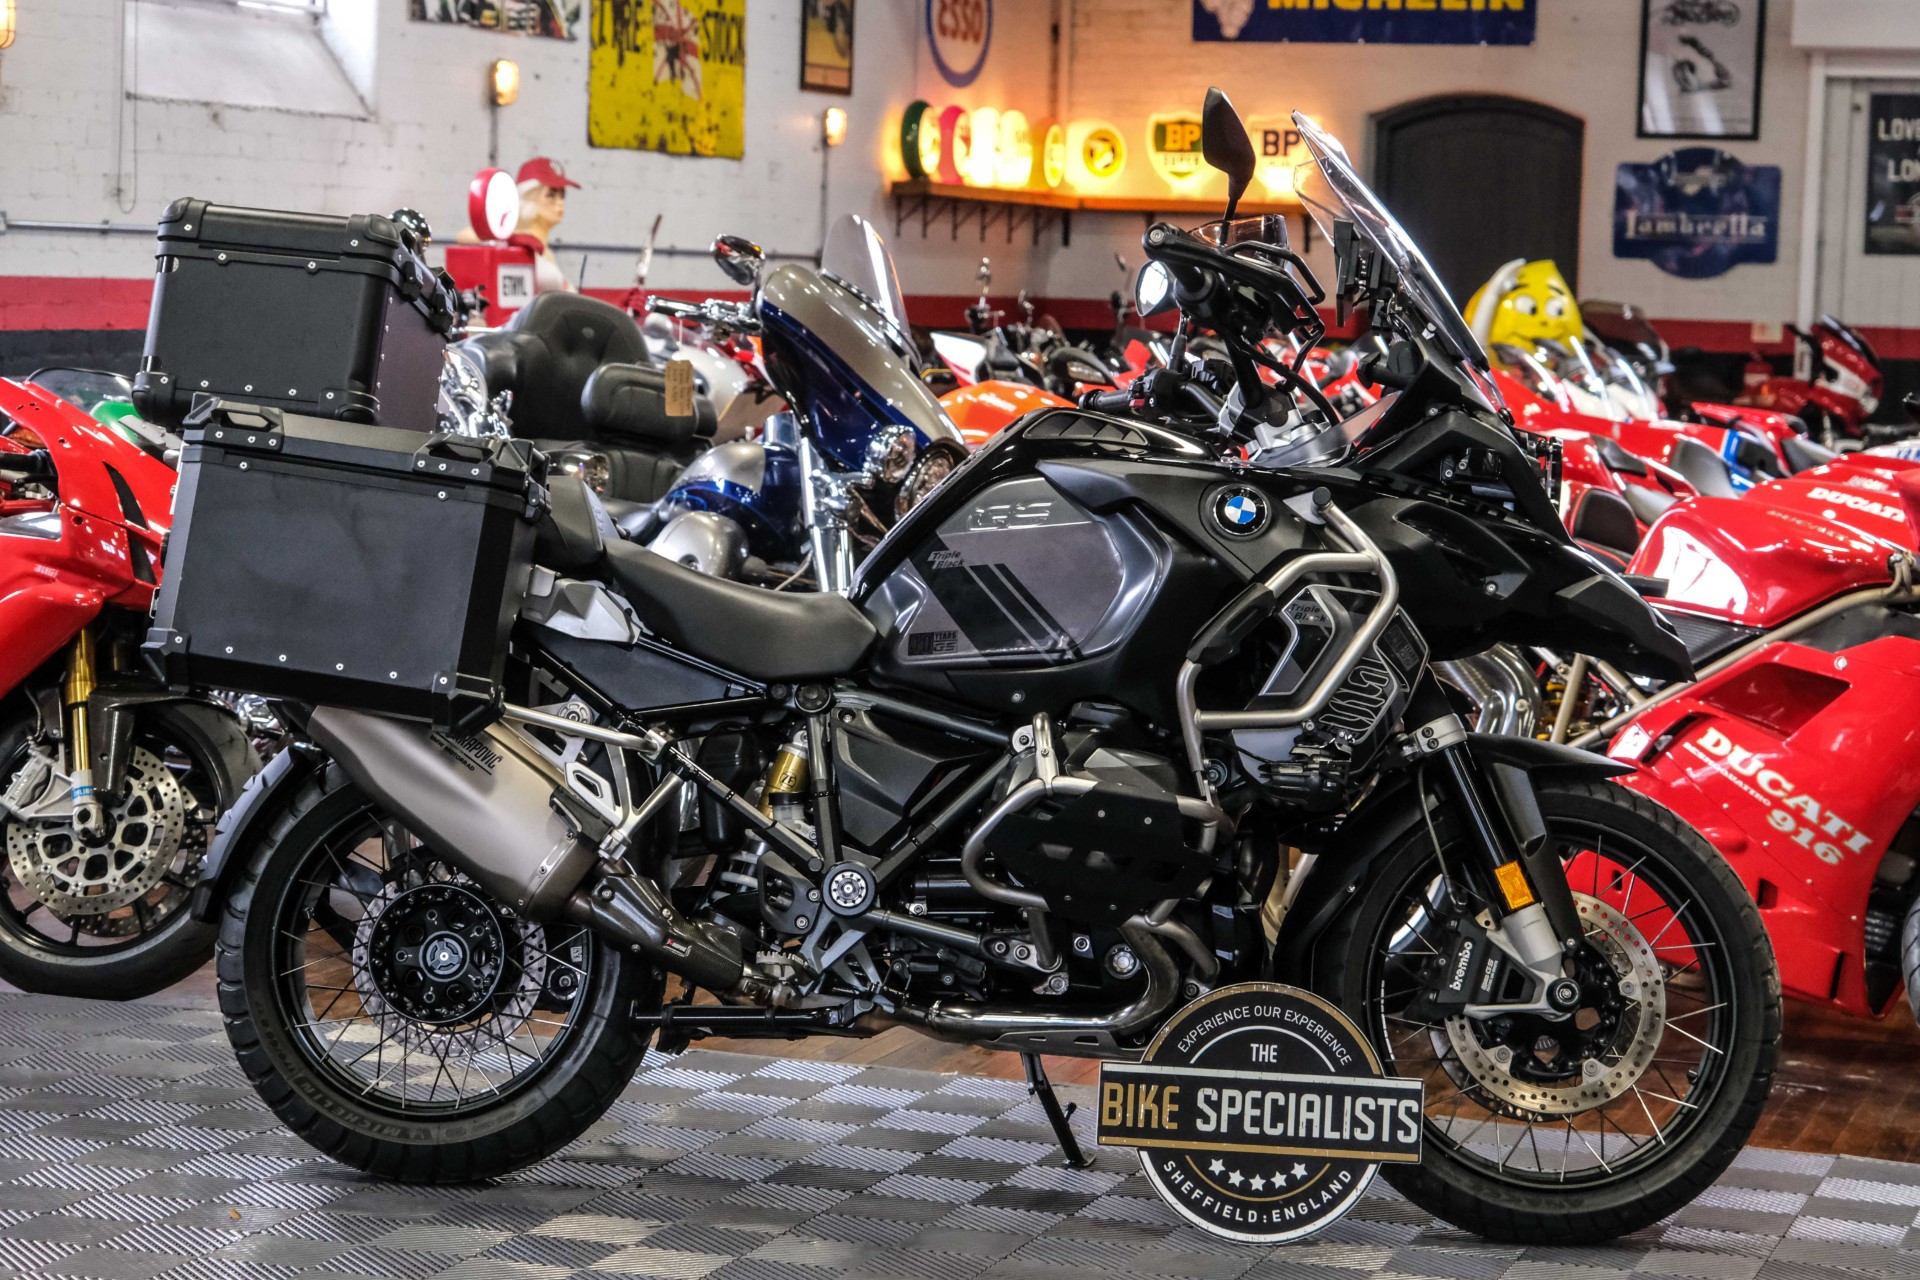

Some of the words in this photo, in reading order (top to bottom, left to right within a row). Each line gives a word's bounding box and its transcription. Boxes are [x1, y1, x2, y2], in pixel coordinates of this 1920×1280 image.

[1164, 123, 1200, 151] BP
[1263, 130, 1300, 156] BP
[932, 551, 961, 561] Triple
[1291, 603, 1321, 613] Triple
[1697, 727, 1872, 854] DUCATI
[1766, 809, 1844, 866] 916
[1449, 941, 1473, 991] brembo
[1177, 1005, 1251, 1054] EXPERIENCE
[1254, 1004, 1281, 1019] OUR
[1284, 1009, 1352, 1067] EXPERIENCE
[1250, 1043, 1278, 1064] THE
[301, 1079, 401, 1139] MICHELIN
[1101, 1081, 1181, 1131] BIKE
[1195, 1087, 1420, 1144] SPECIALISTS
